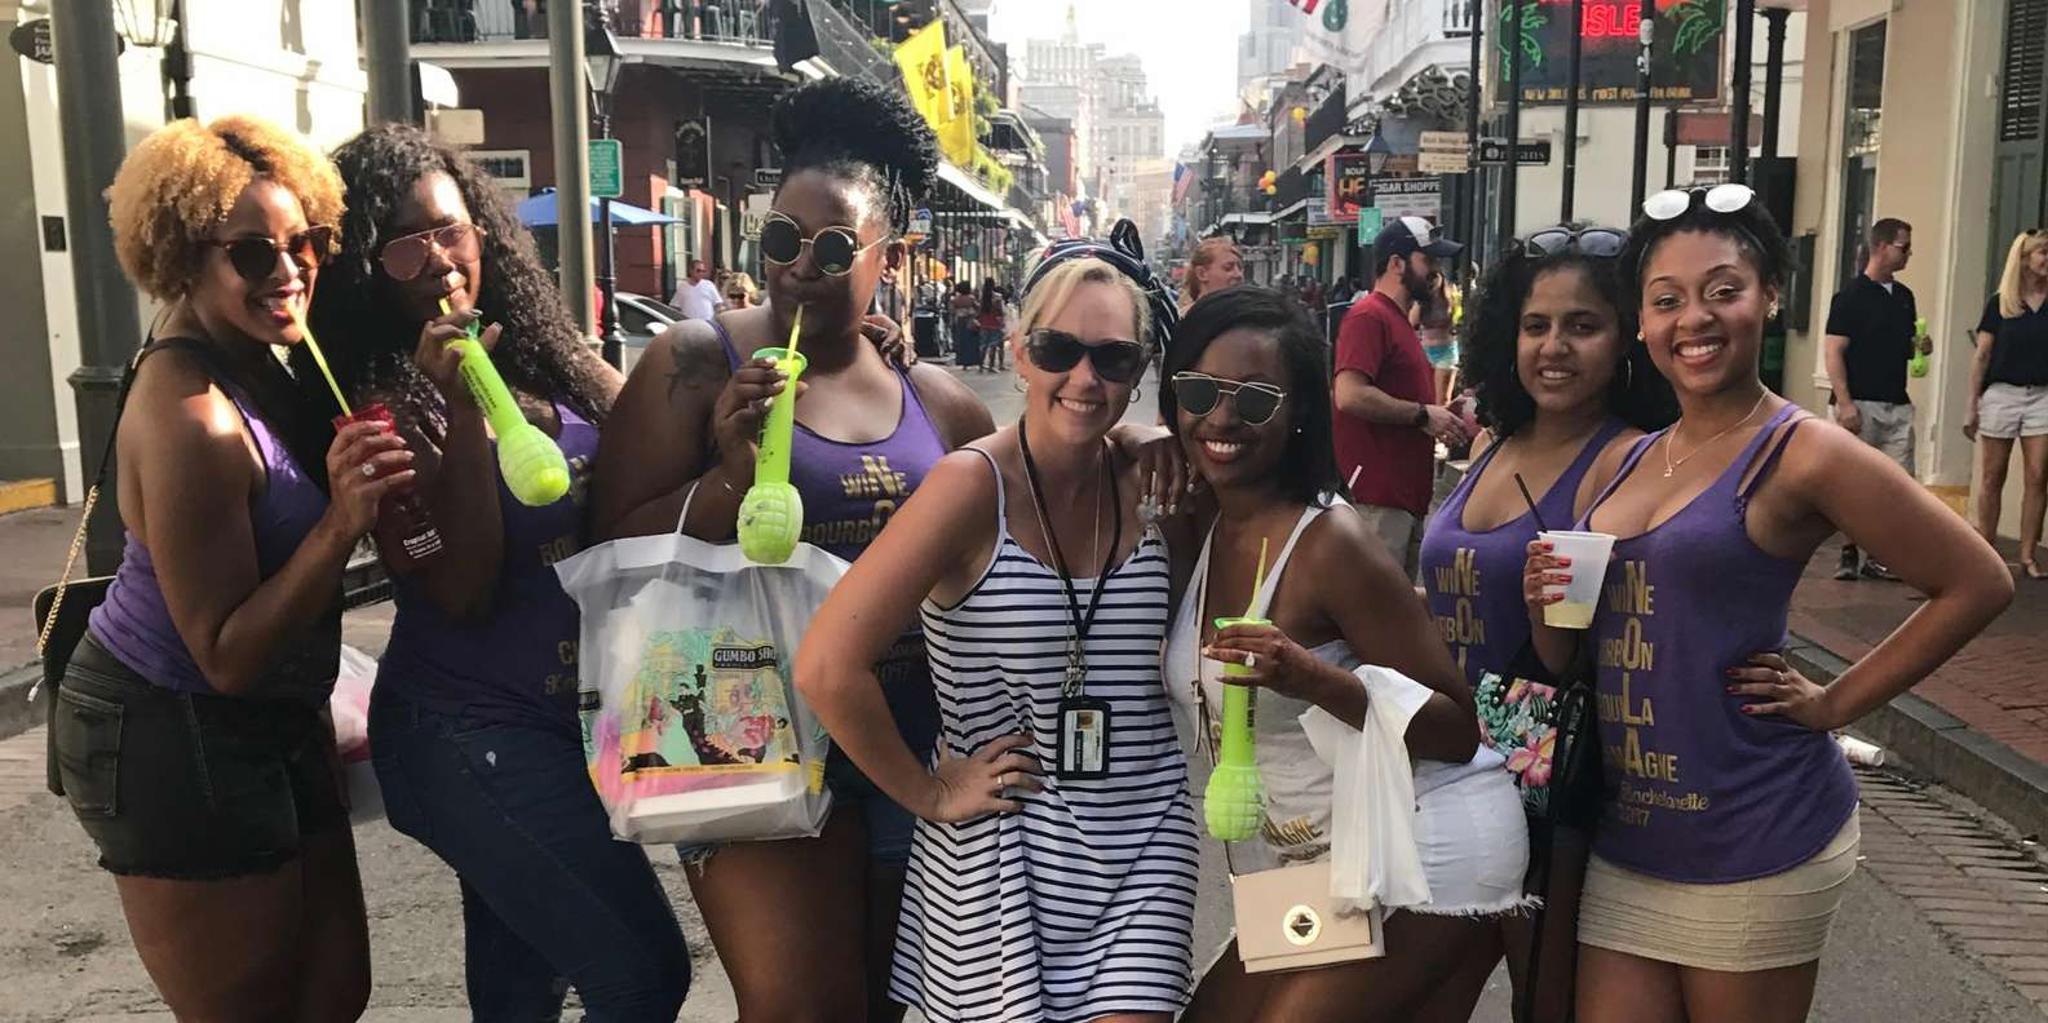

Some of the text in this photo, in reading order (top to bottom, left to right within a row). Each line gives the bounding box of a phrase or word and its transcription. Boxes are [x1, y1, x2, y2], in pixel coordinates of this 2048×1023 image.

[1581, 4, 1642, 37] ISLE
[1485, 146, 1546, 160] Orans
[1434, 547, 1481, 596] WINE
[1607, 560, 1655, 616] WINE
[714, 650, 756, 663] GUMBO
